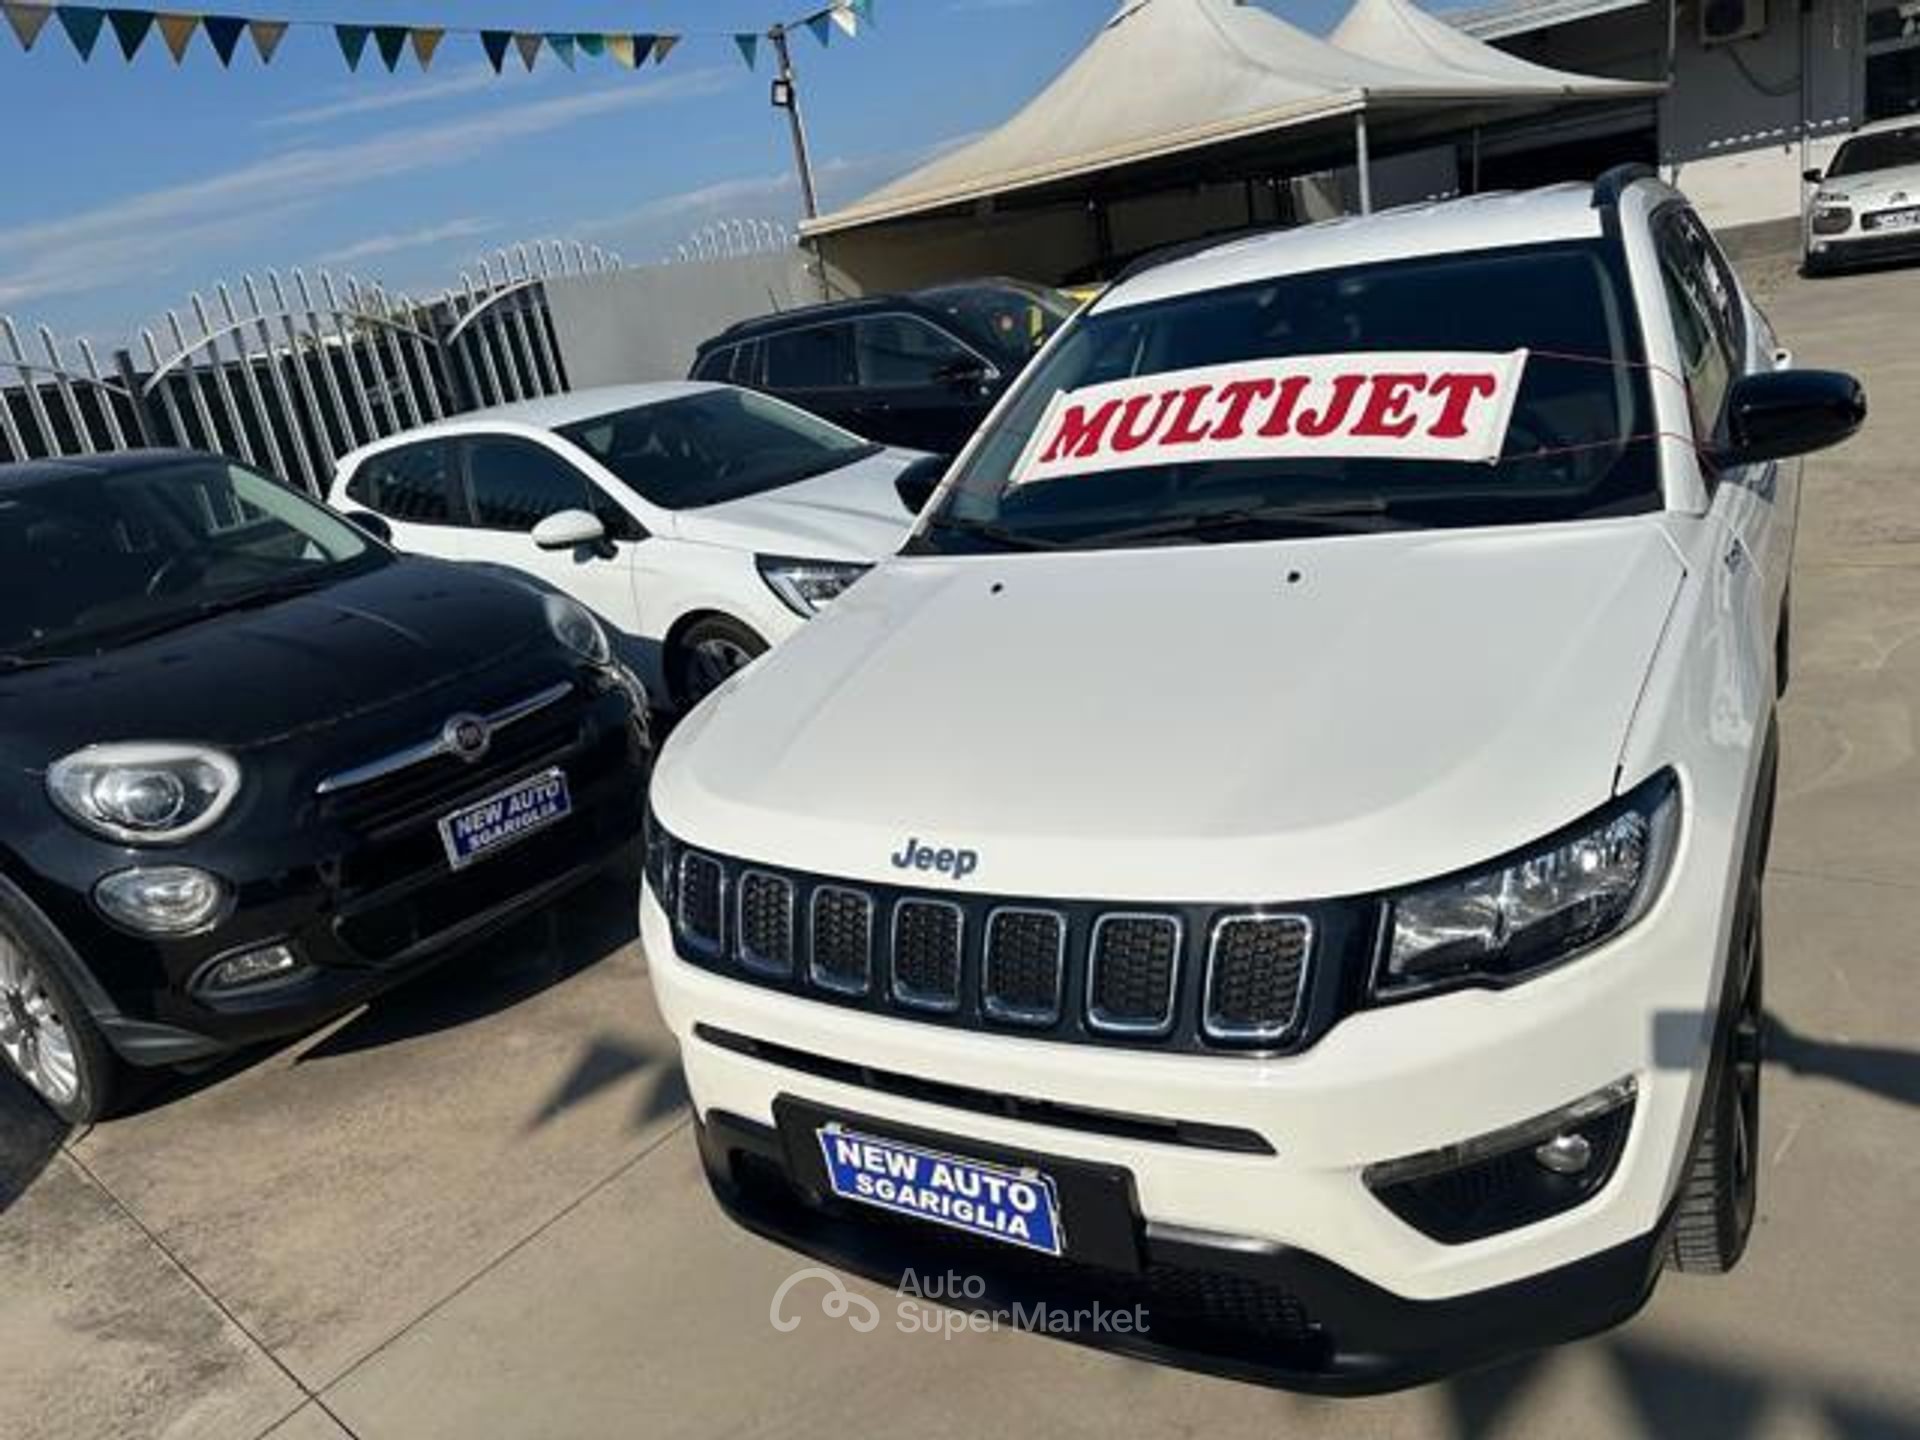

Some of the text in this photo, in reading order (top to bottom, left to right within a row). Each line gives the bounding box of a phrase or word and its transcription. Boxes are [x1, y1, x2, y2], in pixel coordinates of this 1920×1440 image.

[1039, 373, 1495, 463] MULTIJET
[456, 781, 560, 838] NEW AUTO
[891, 837, 978, 880] Jeep
[834, 1139, 1037, 1213] NEW AUTO
[856, 1173, 1030, 1239] SGARIGLIA
